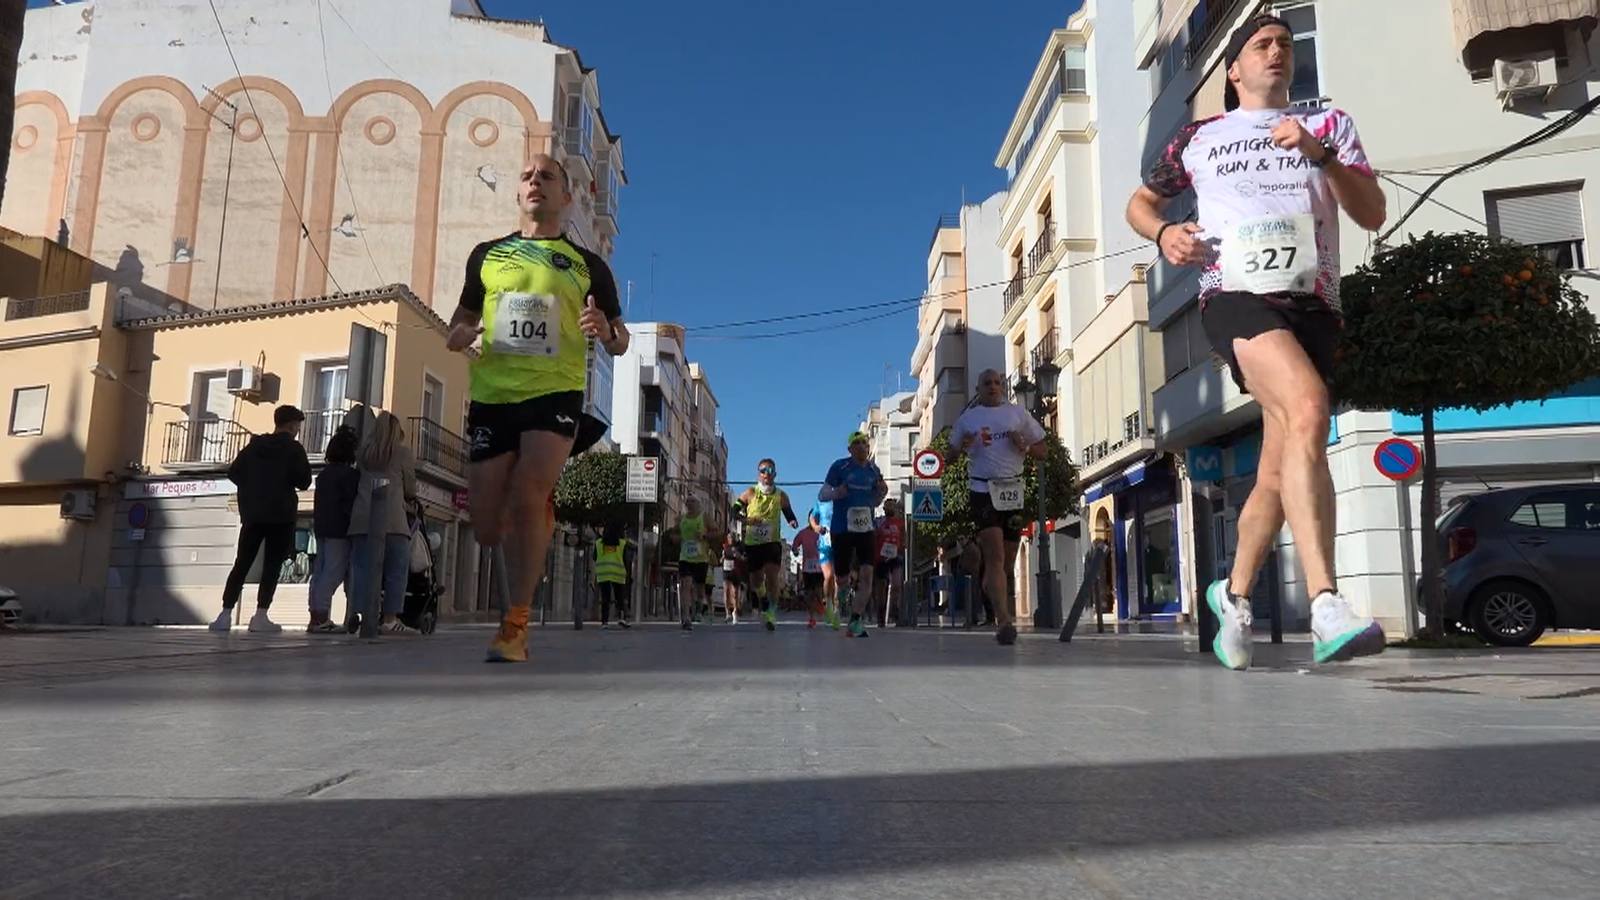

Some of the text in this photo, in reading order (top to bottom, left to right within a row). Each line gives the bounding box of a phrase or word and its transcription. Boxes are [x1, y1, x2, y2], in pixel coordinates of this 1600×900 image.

[1207, 137, 1276, 161] ANTIGR
[1216, 160, 1249, 176] RUN
[1256, 158, 1271, 171] &
[1245, 246, 1297, 273] 327
[509, 319, 548, 340] 104
[999, 490, 1019, 501] 428
